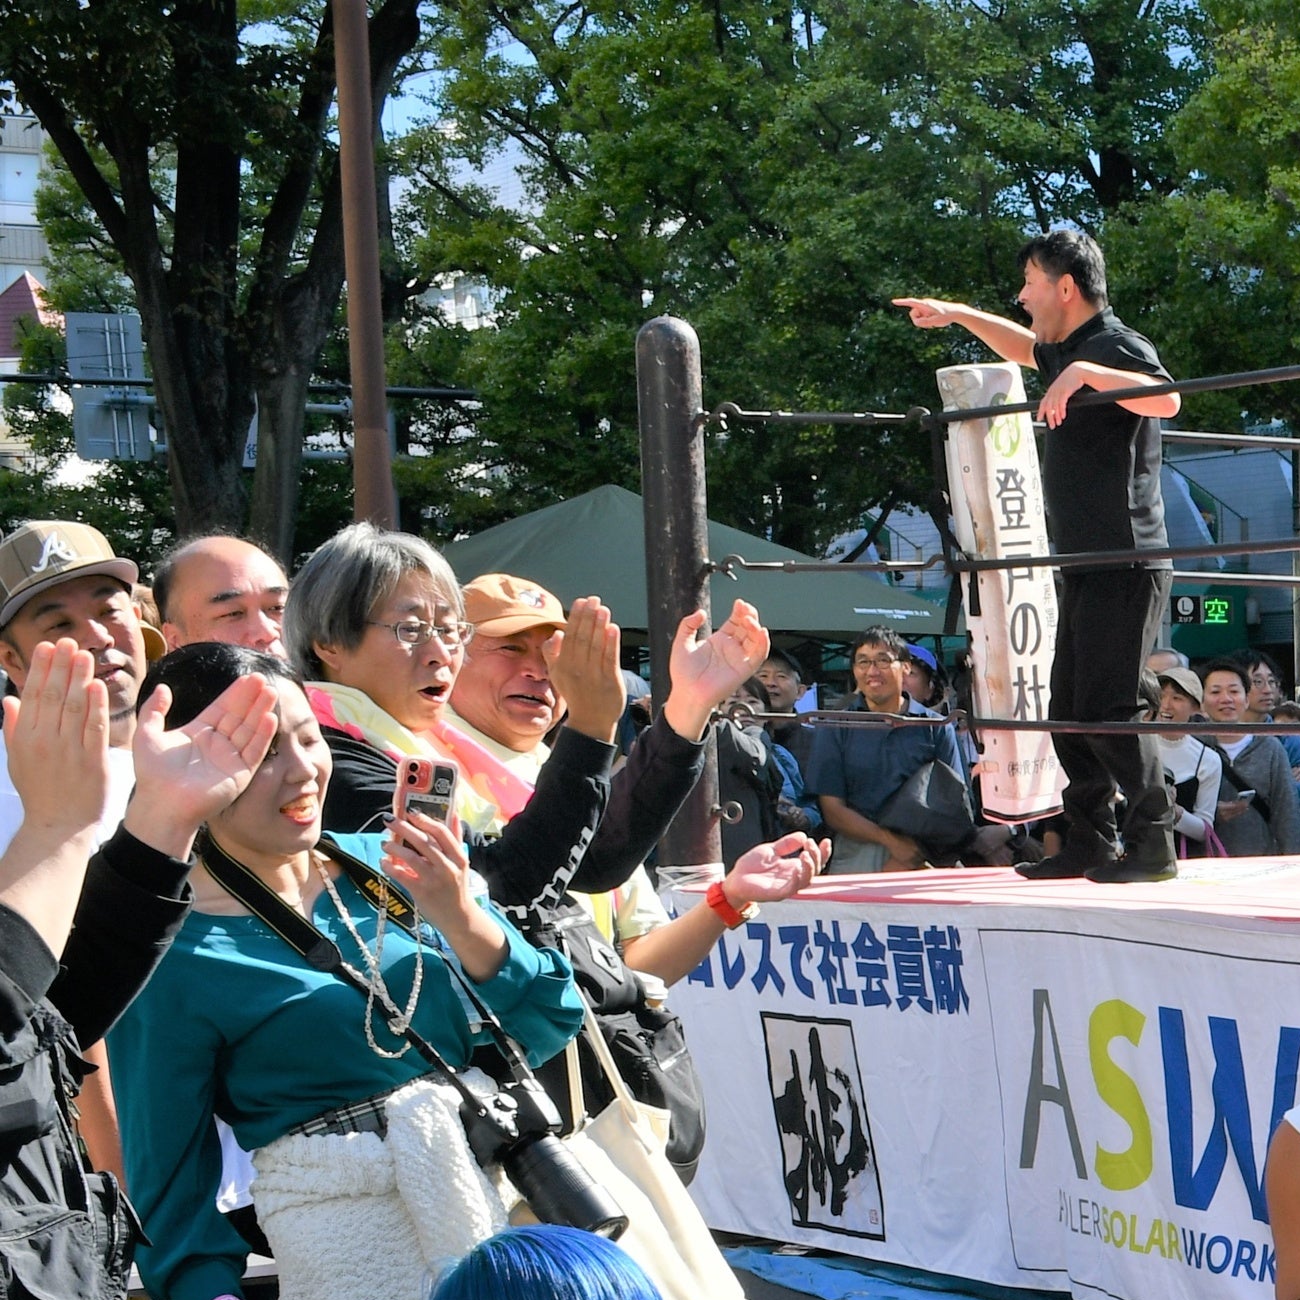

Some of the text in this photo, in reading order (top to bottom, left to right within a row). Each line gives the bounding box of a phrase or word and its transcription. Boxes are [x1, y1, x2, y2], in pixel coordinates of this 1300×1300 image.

[995, 467, 1046, 721] 登戸の杜
[1181, 600, 1190, 612] L
[1205, 598, 1229, 624] 空
[667, 904, 970, 1015] レスで社会貢献
